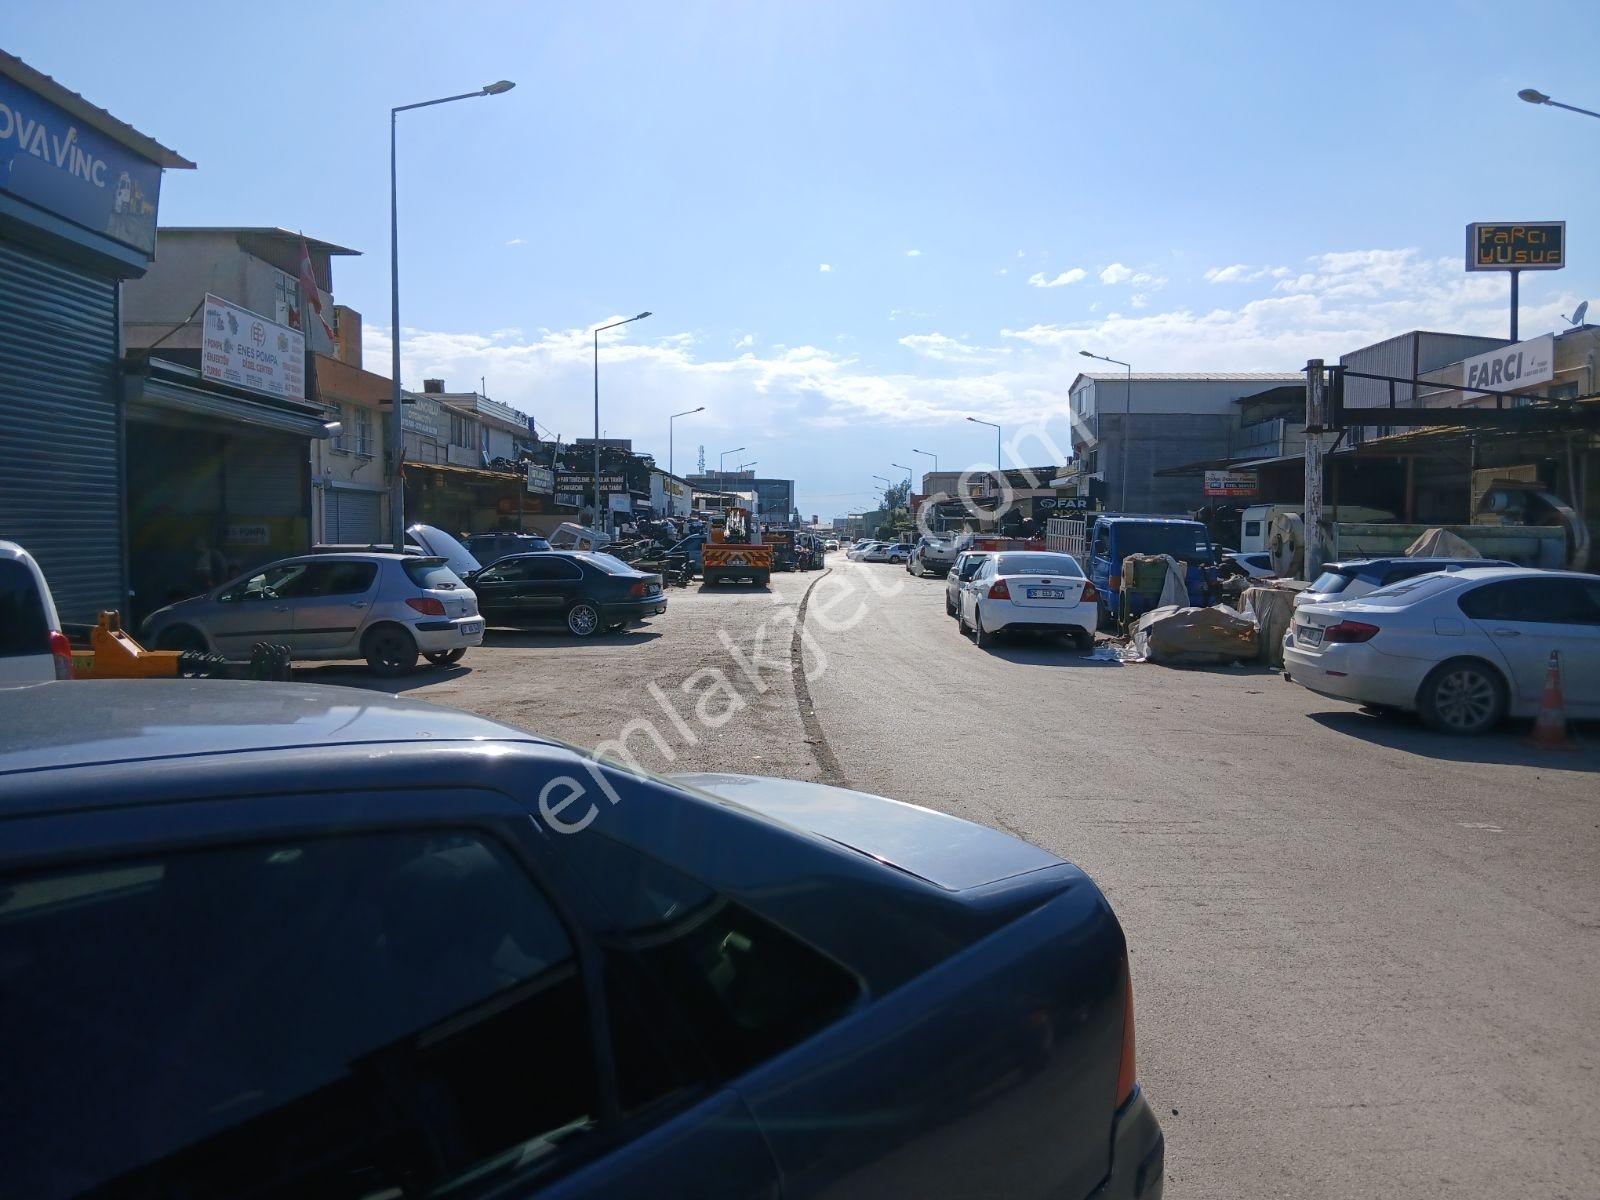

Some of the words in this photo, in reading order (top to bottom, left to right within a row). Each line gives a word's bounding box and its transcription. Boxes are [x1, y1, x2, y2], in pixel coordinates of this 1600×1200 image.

[238, 344, 255, 359] ENES
[255, 350, 278, 366] POMPA
[1468, 351, 1524, 391] FARCI
[1057, 497, 1087, 508] FAR
